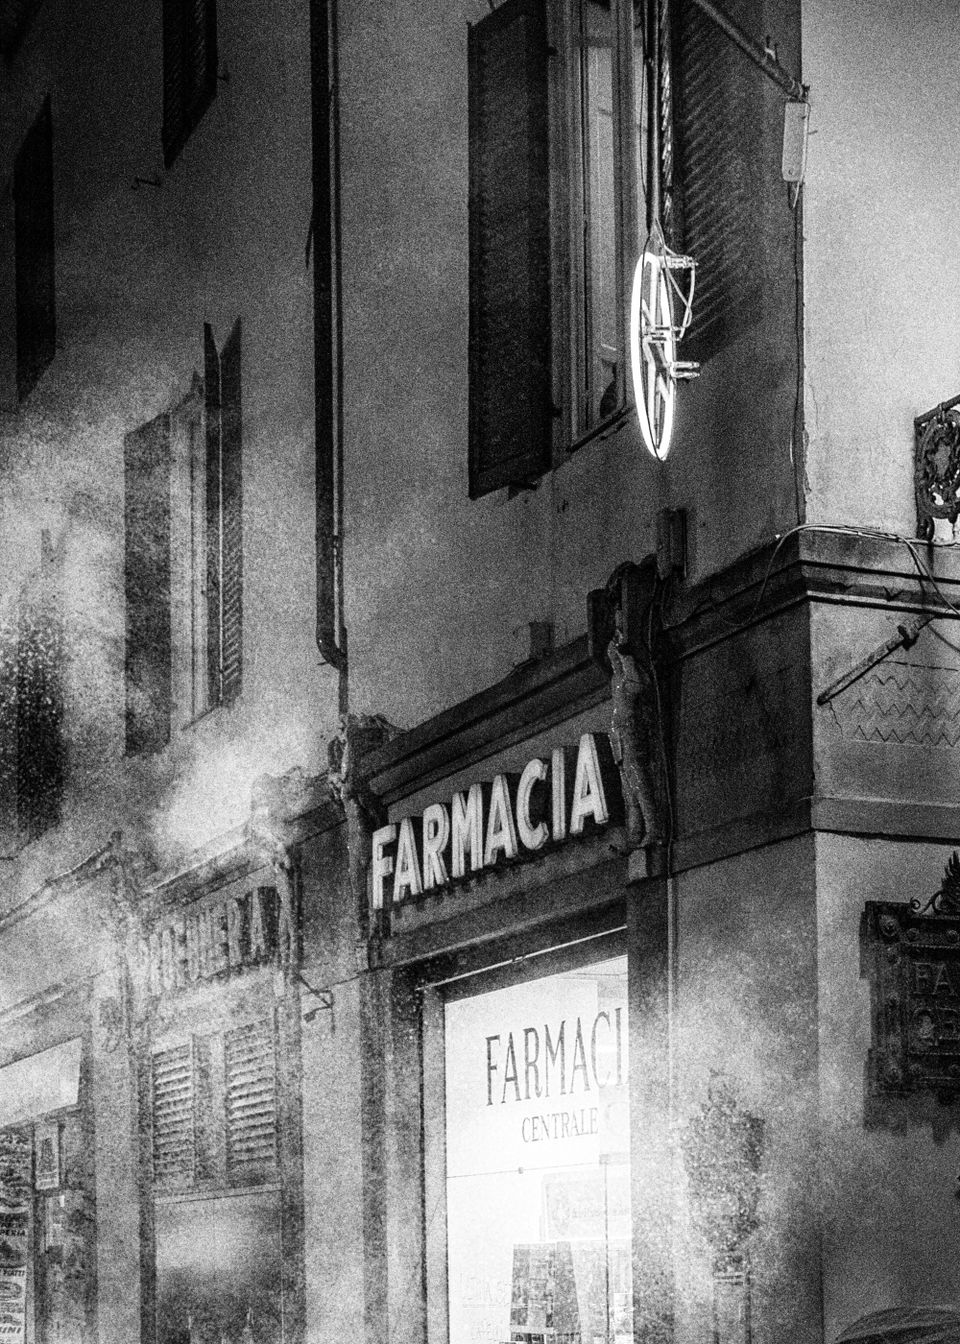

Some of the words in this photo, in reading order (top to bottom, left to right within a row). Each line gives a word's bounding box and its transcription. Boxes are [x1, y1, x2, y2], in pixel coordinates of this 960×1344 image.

[372, 733, 609, 909] FARMACIA
[486, 1007, 627, 1106] FARMACI
[521, 1107, 599, 1143] CENTRALE
